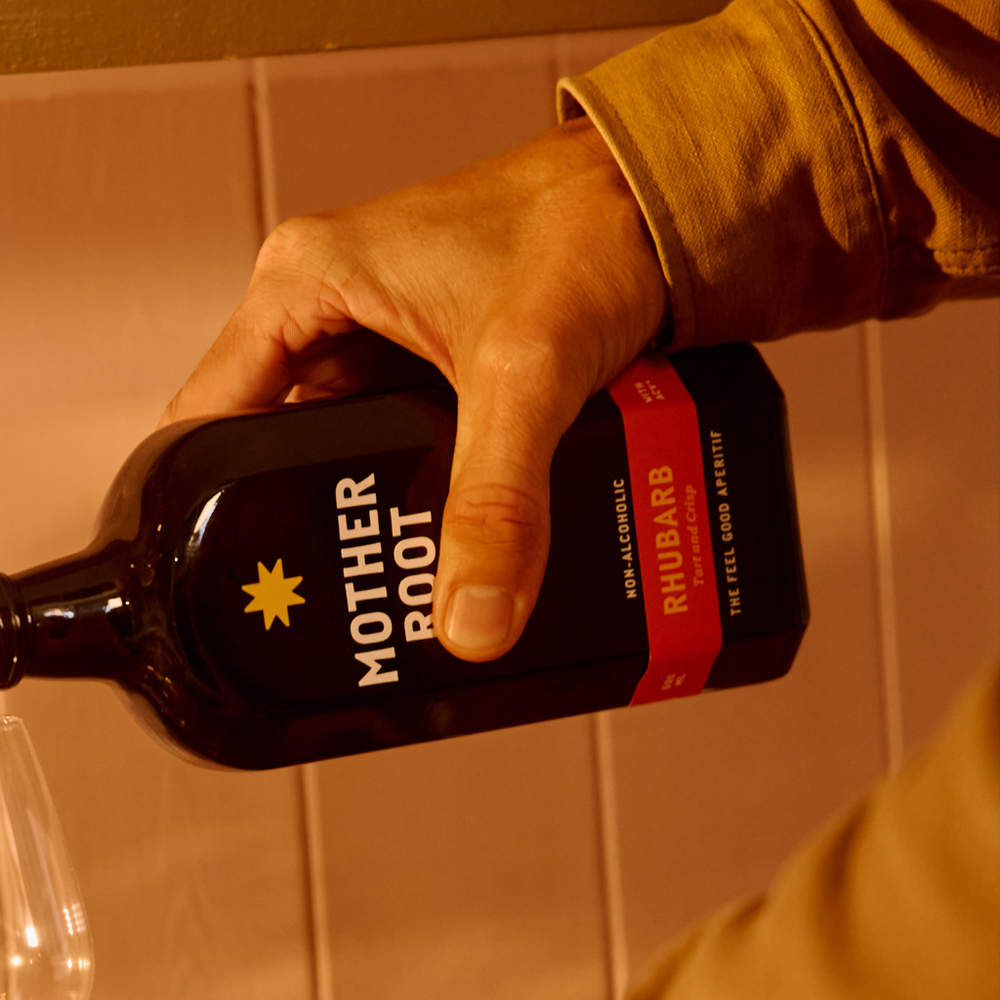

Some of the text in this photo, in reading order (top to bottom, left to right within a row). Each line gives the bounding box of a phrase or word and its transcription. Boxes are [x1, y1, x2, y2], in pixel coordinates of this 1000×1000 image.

[335, 472, 399, 687] MOTHER
[389, 506, 438, 643] ROOT
[613, 478, 638, 599] NON-ALCOHOLIC
[648, 465, 689, 615] RHUBARB
[684, 484, 705, 587] Tart and Crisp
[710, 430, 742, 617] THE FEEL GOOD APERITIF
